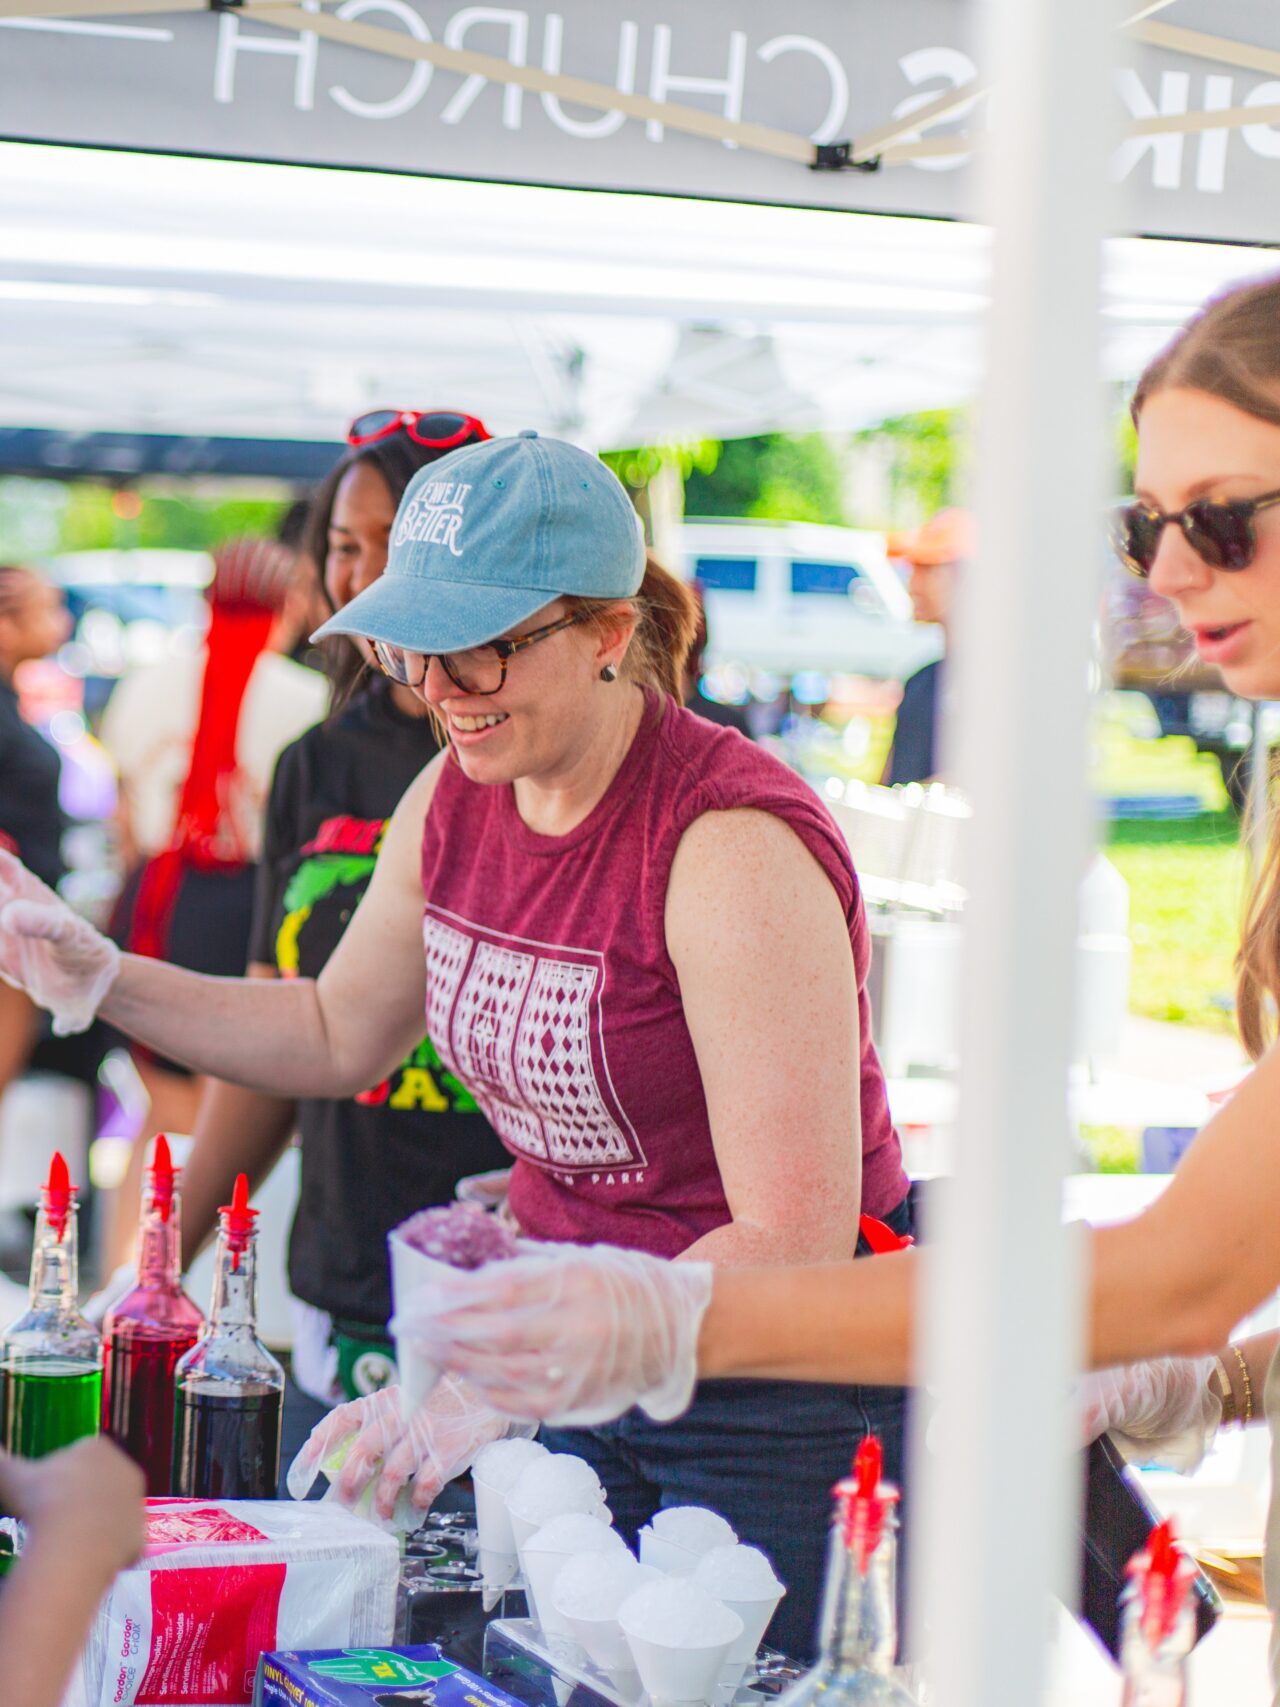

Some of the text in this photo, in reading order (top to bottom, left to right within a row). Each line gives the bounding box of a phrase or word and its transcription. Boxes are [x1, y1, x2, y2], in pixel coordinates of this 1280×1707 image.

[452, 483, 473, 505] IT
[395, 501, 464, 556] BETTER
[591, 1171, 645, 1185] PARK
[121, 1618, 133, 1658] Gordon
[113, 1666, 127, 1703] Gordon
